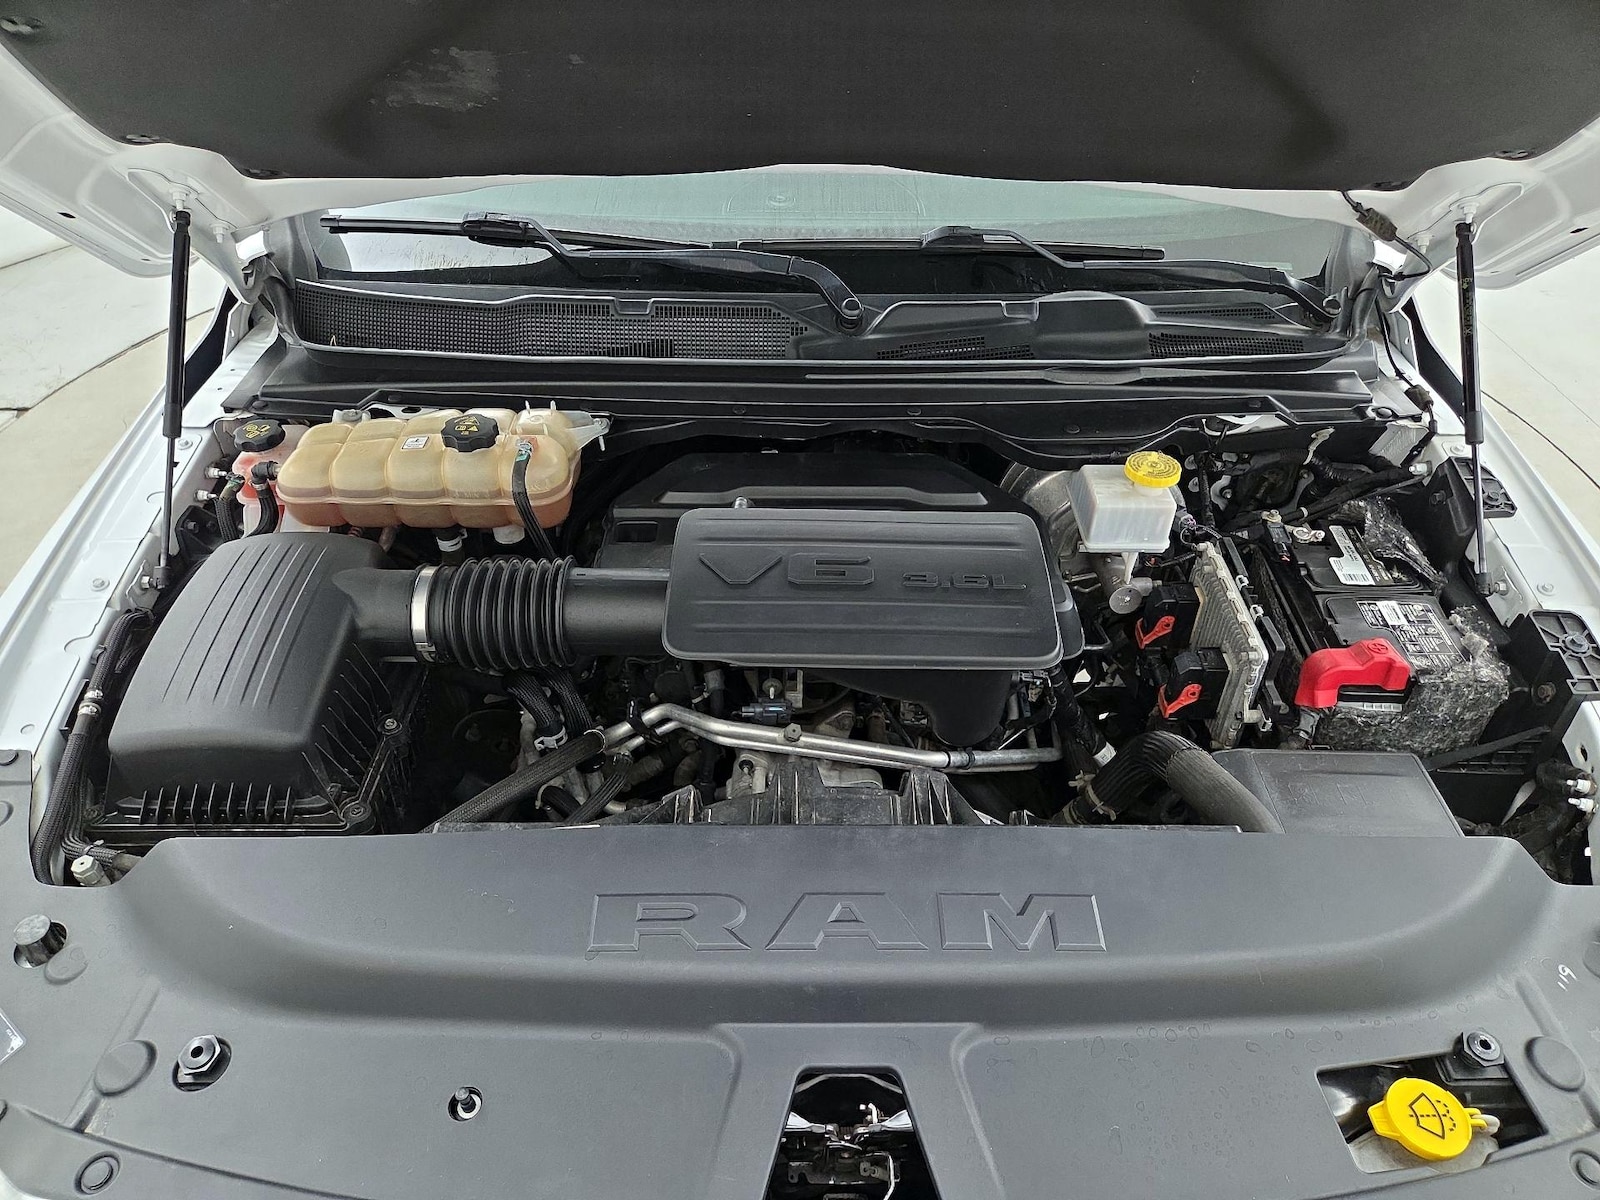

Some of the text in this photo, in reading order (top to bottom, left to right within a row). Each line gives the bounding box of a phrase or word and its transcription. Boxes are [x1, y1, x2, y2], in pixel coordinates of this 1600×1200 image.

[699, 552, 1027, 590] V6 3.6L
[586, 892, 1107, 952] RAM
